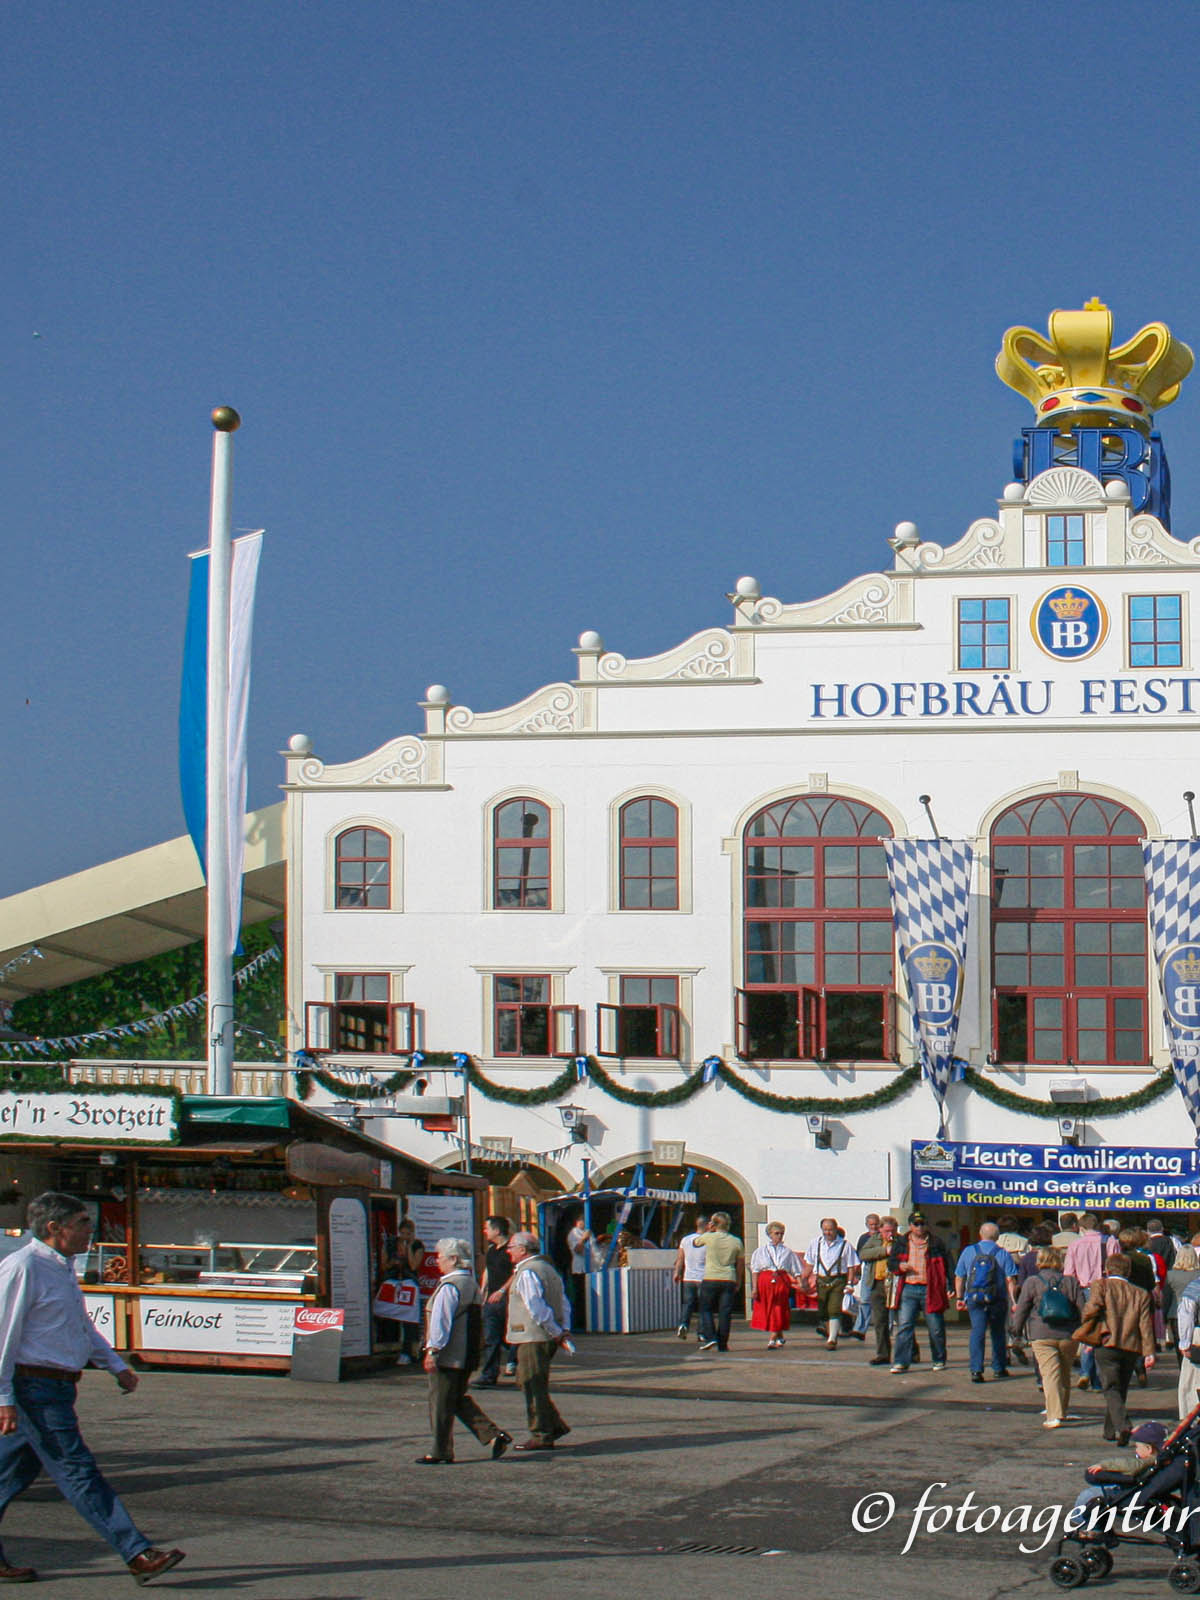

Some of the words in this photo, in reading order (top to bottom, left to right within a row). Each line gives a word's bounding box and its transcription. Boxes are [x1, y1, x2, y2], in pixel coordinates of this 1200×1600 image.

[1052, 620, 1090, 649] HB
[810, 675, 1053, 717] HOFBRÄU
[917, 983, 952, 1013] HB
[67, 1100, 166, 1132] Brotzeit
[961, 1146, 1033, 1168] Heute
[1043, 1148, 1183, 1174] Familientag
[1190, 1152, 1197, 1171] !
[920, 1174, 997, 1194] Speisen
[1002, 1178, 1038, 1192] und
[1044, 1179, 1133, 1196] Getränke
[943, 1193, 961, 1203] im
[967, 1193, 1080, 1209] Kinderbereich
[1084, 1197, 1112, 1209] auf
[1117, 1197, 1150, 1210] dem
[144, 1309, 223, 1329] Feinkost
